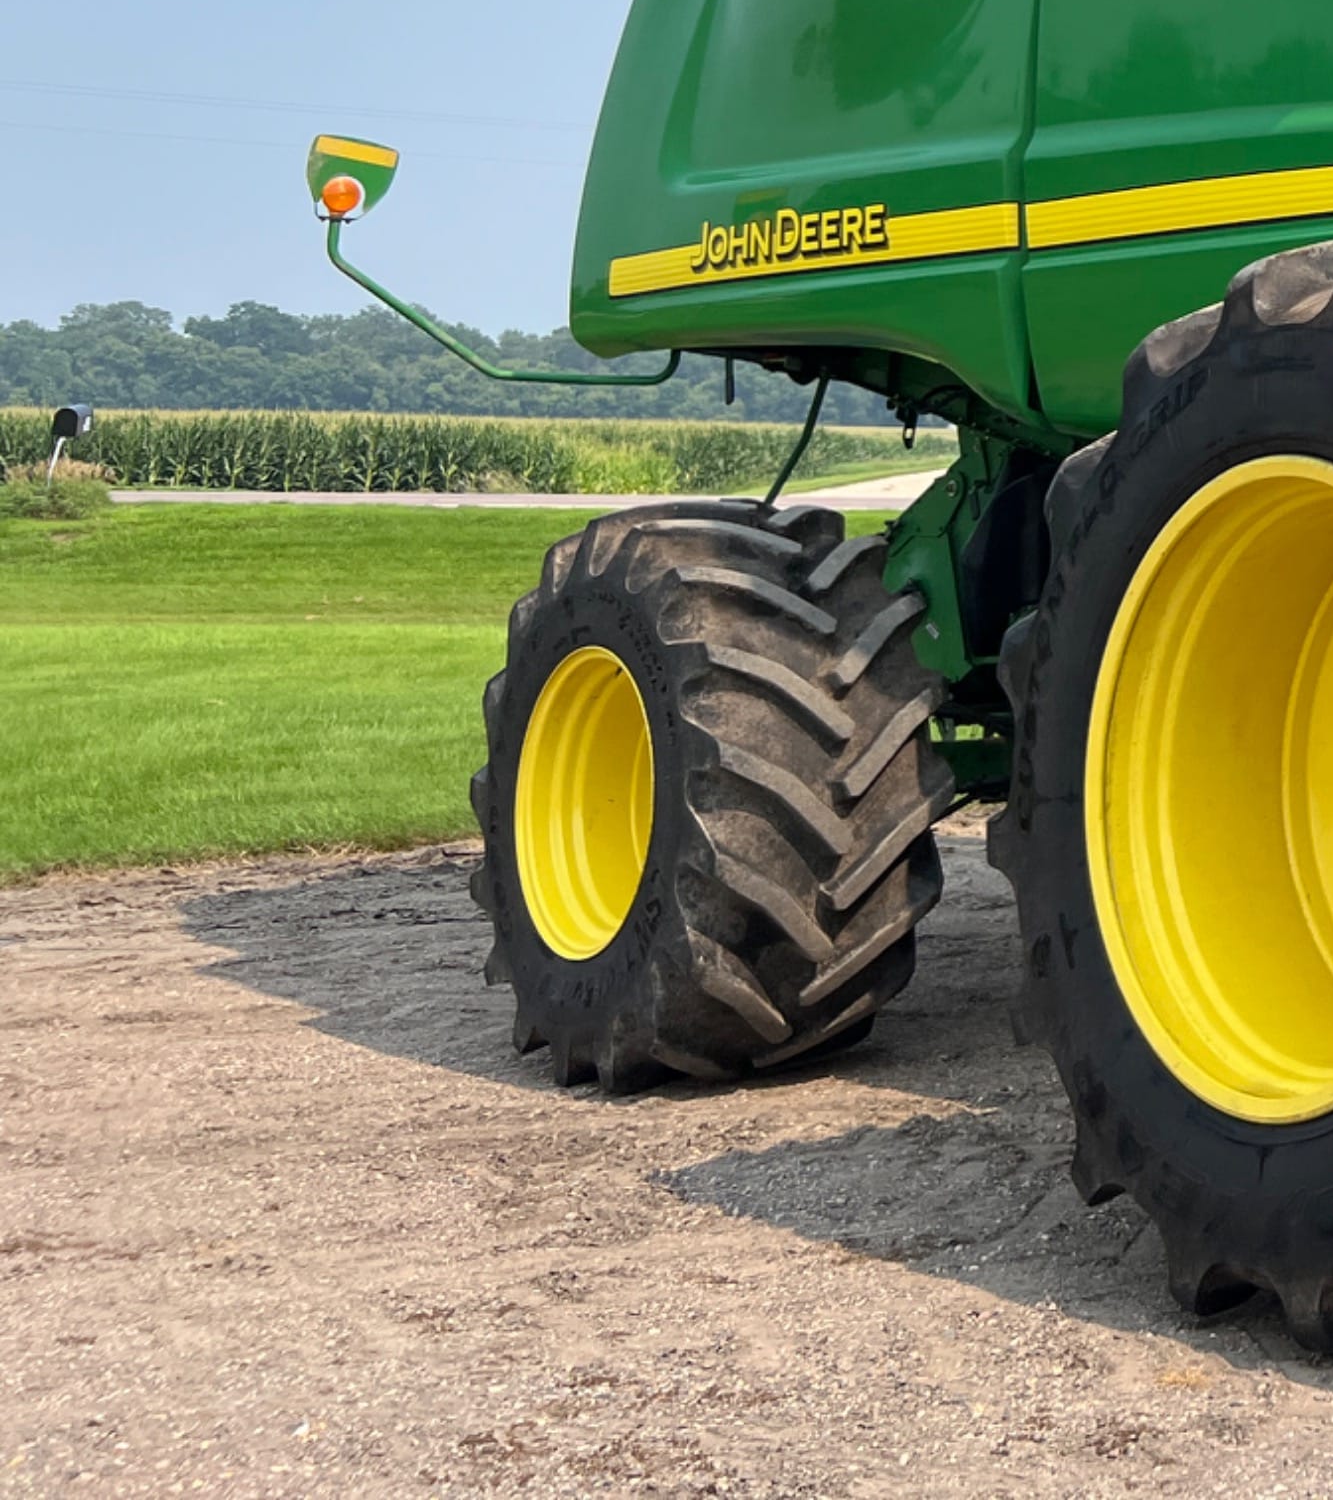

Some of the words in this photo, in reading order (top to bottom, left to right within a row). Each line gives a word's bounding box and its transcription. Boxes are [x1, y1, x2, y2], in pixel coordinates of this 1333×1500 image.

[689, 219, 772, 271] JOHN
[775, 202, 888, 256] DEERE
[1127, 367, 1213, 453] GRIP
